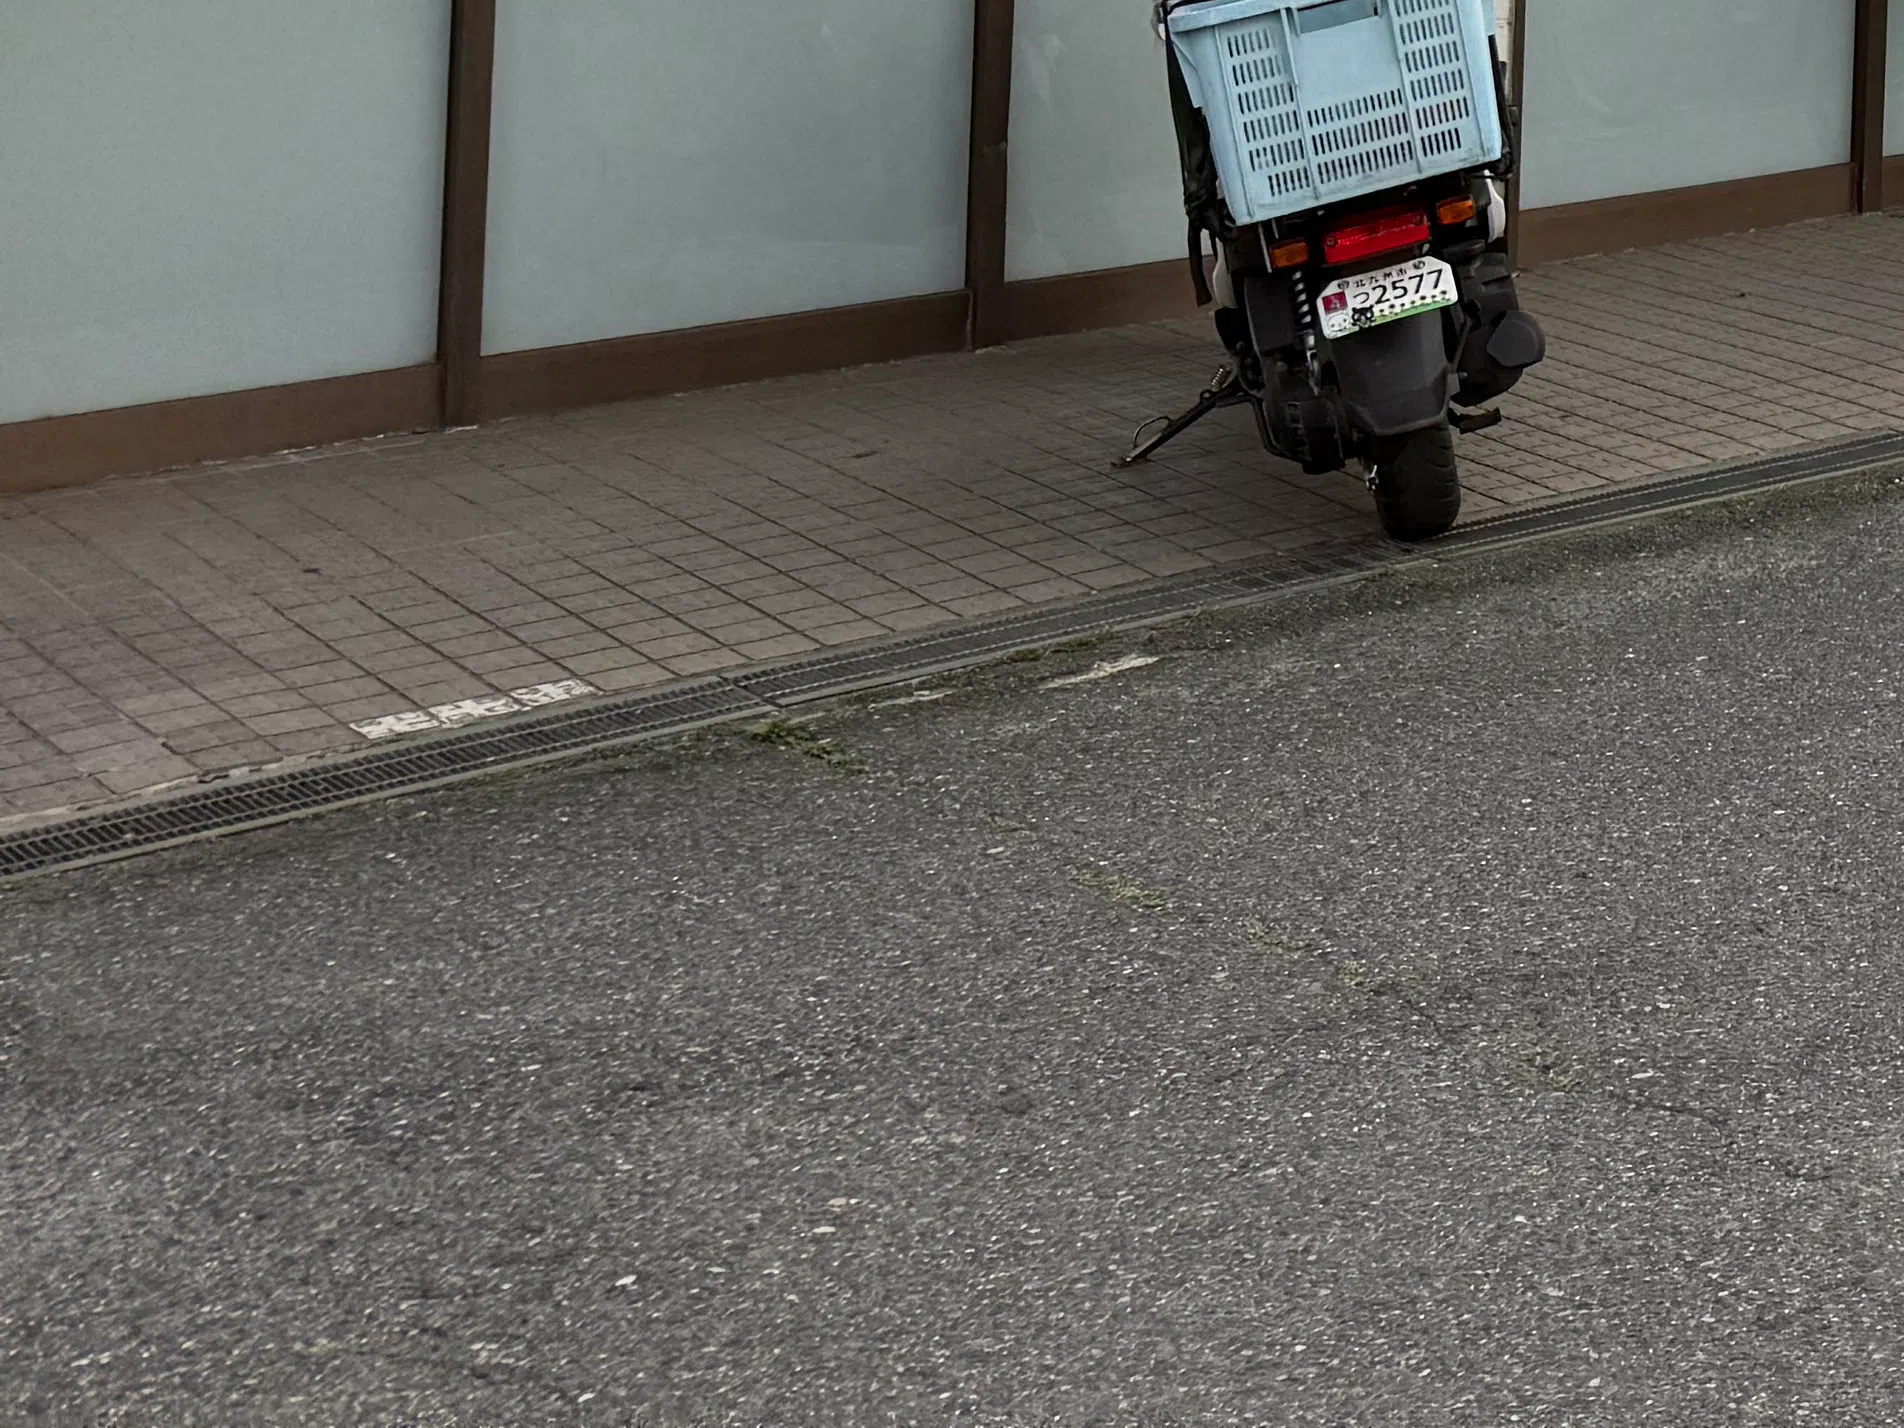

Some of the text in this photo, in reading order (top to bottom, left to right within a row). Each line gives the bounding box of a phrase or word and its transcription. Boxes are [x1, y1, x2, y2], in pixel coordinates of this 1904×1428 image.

[1353, 266, 1408, 288] 北九州市
[1371, 268, 1444, 305] 2577
